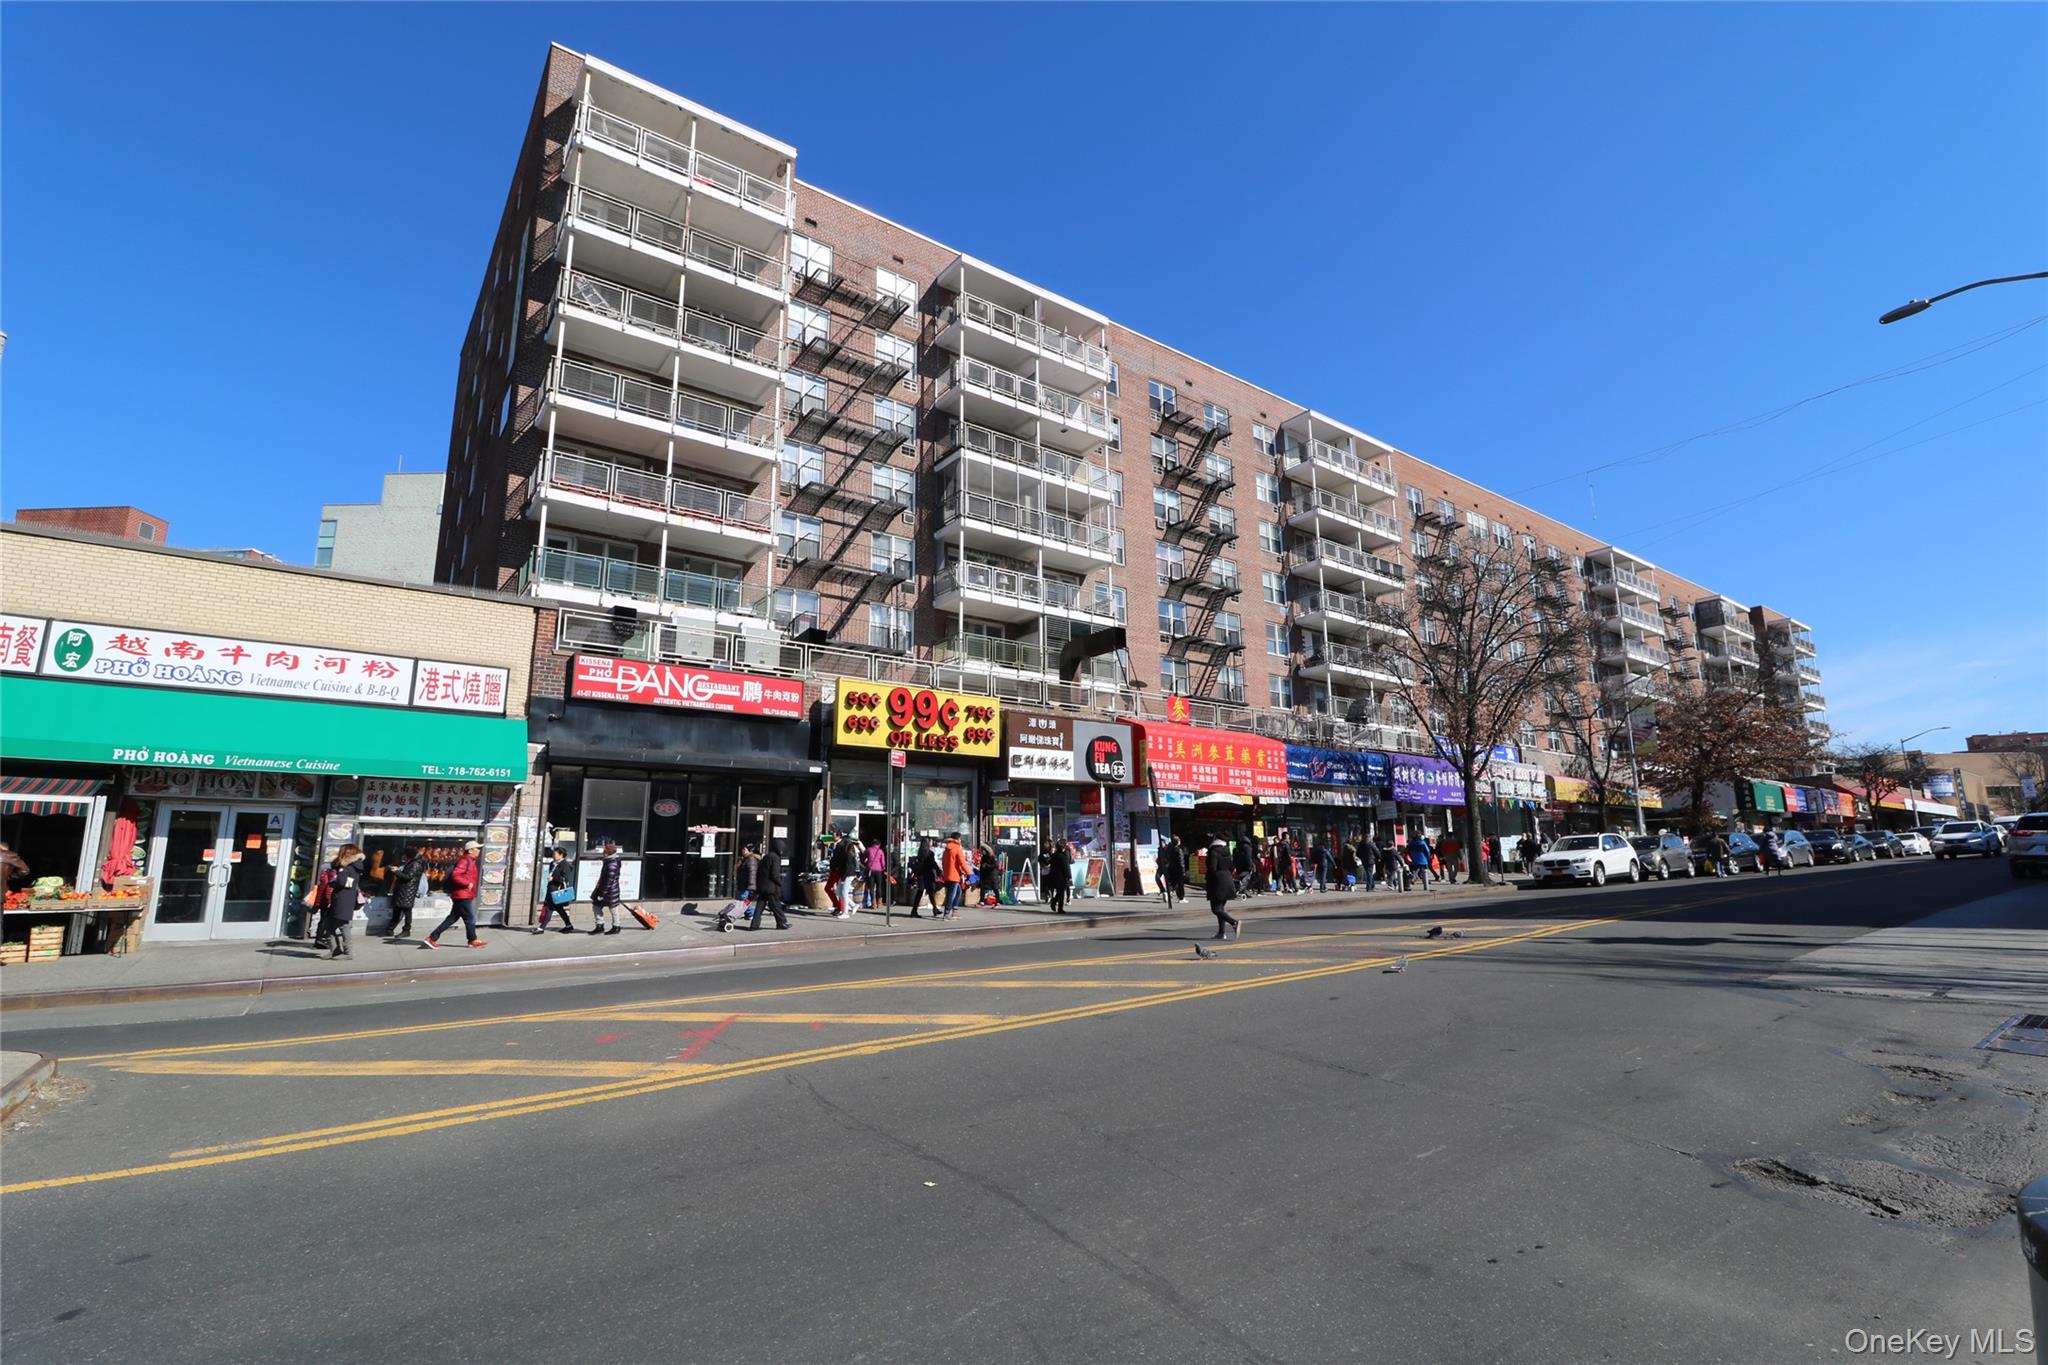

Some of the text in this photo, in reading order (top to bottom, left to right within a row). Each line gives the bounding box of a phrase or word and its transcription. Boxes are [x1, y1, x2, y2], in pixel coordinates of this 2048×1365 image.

[62, 630, 86, 669] 阿宏
[106, 633, 400, 679] 越南牛肉河粉
[580, 658, 611, 667] KISSENA
[249, 673, 310, 690] Vietnamese
[312, 678, 352, 694] Cuisine
[354, 683, 363, 695] &
[366, 683, 400, 701] B-B-Q
[764, 689, 800, 703] 牛肉河粉
[847, 691, 881, 708] 59¢
[889, 687, 960, 731] 99¢
[967, 705, 995, 721] 79¢
[847, 714, 881, 732] 69¢
[890, 730, 959, 749] OR LESS
[966, 726, 995, 743] 89¢
[1094, 741, 1117, 753] KUNG
[224, 755, 293, 769] Vietnamese
[296, 758, 341, 771] Cuisine
[1094, 752, 1105, 763] FU
[421, 765, 511, 777] TEL: 718-762-6151
[1095, 763, 1111, 775] TEA
[271, 815, 281, 825] A
